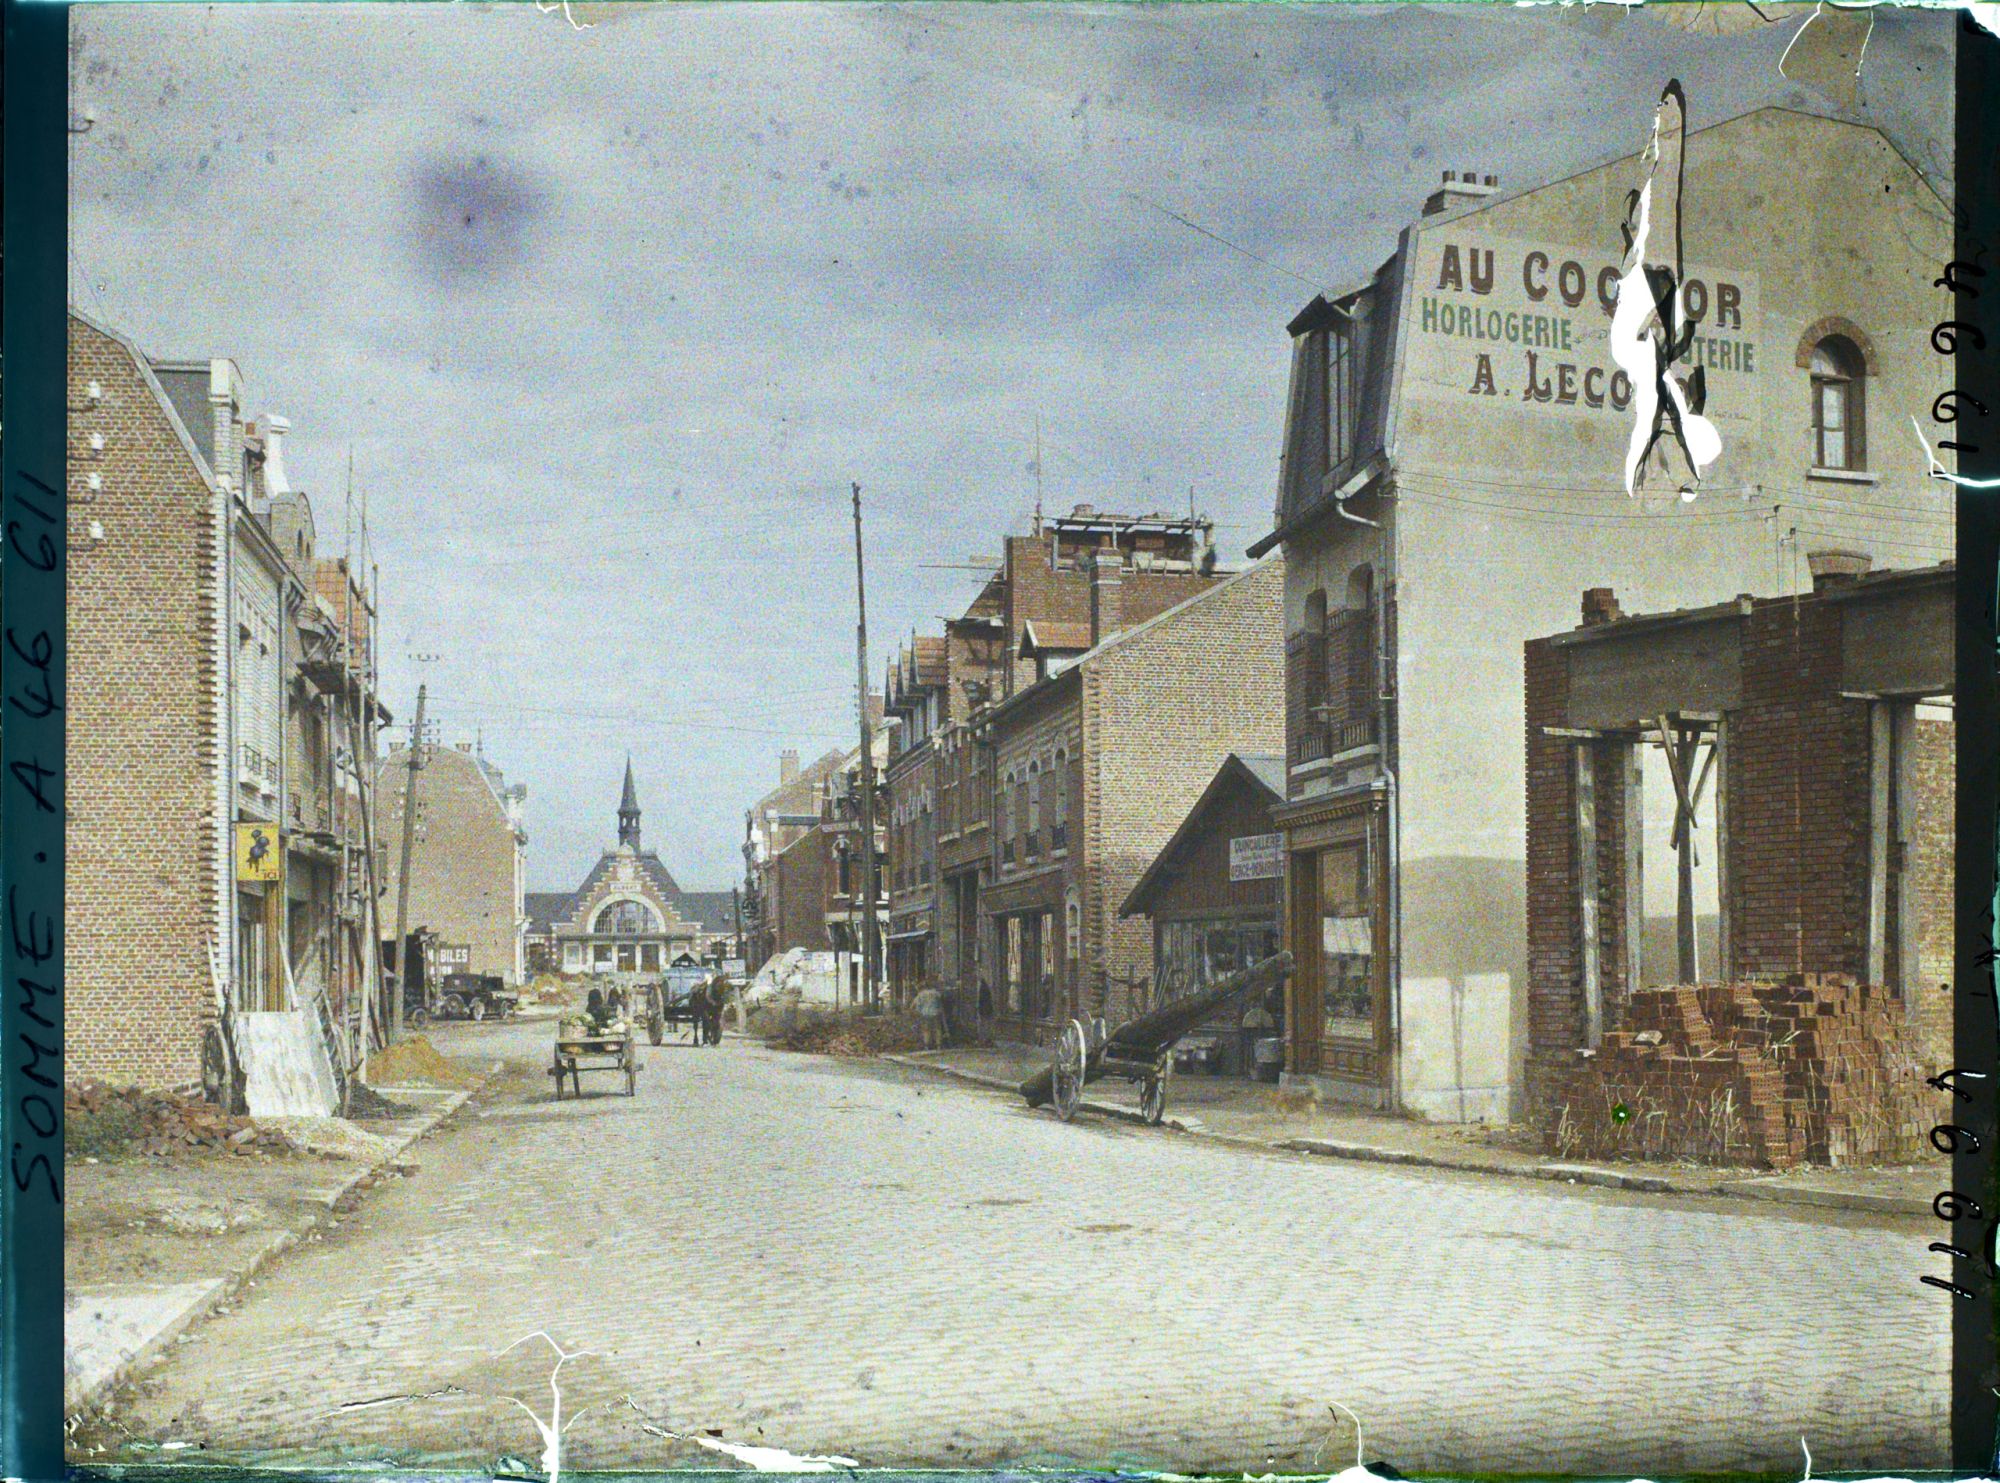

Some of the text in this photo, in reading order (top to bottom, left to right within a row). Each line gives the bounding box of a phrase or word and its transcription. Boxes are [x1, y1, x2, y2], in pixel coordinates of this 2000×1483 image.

[1436, 244, 1495, 295] AU
[1421, 297, 1573, 351] HORLOGERIE
[1468, 352, 1511, 397] A.
